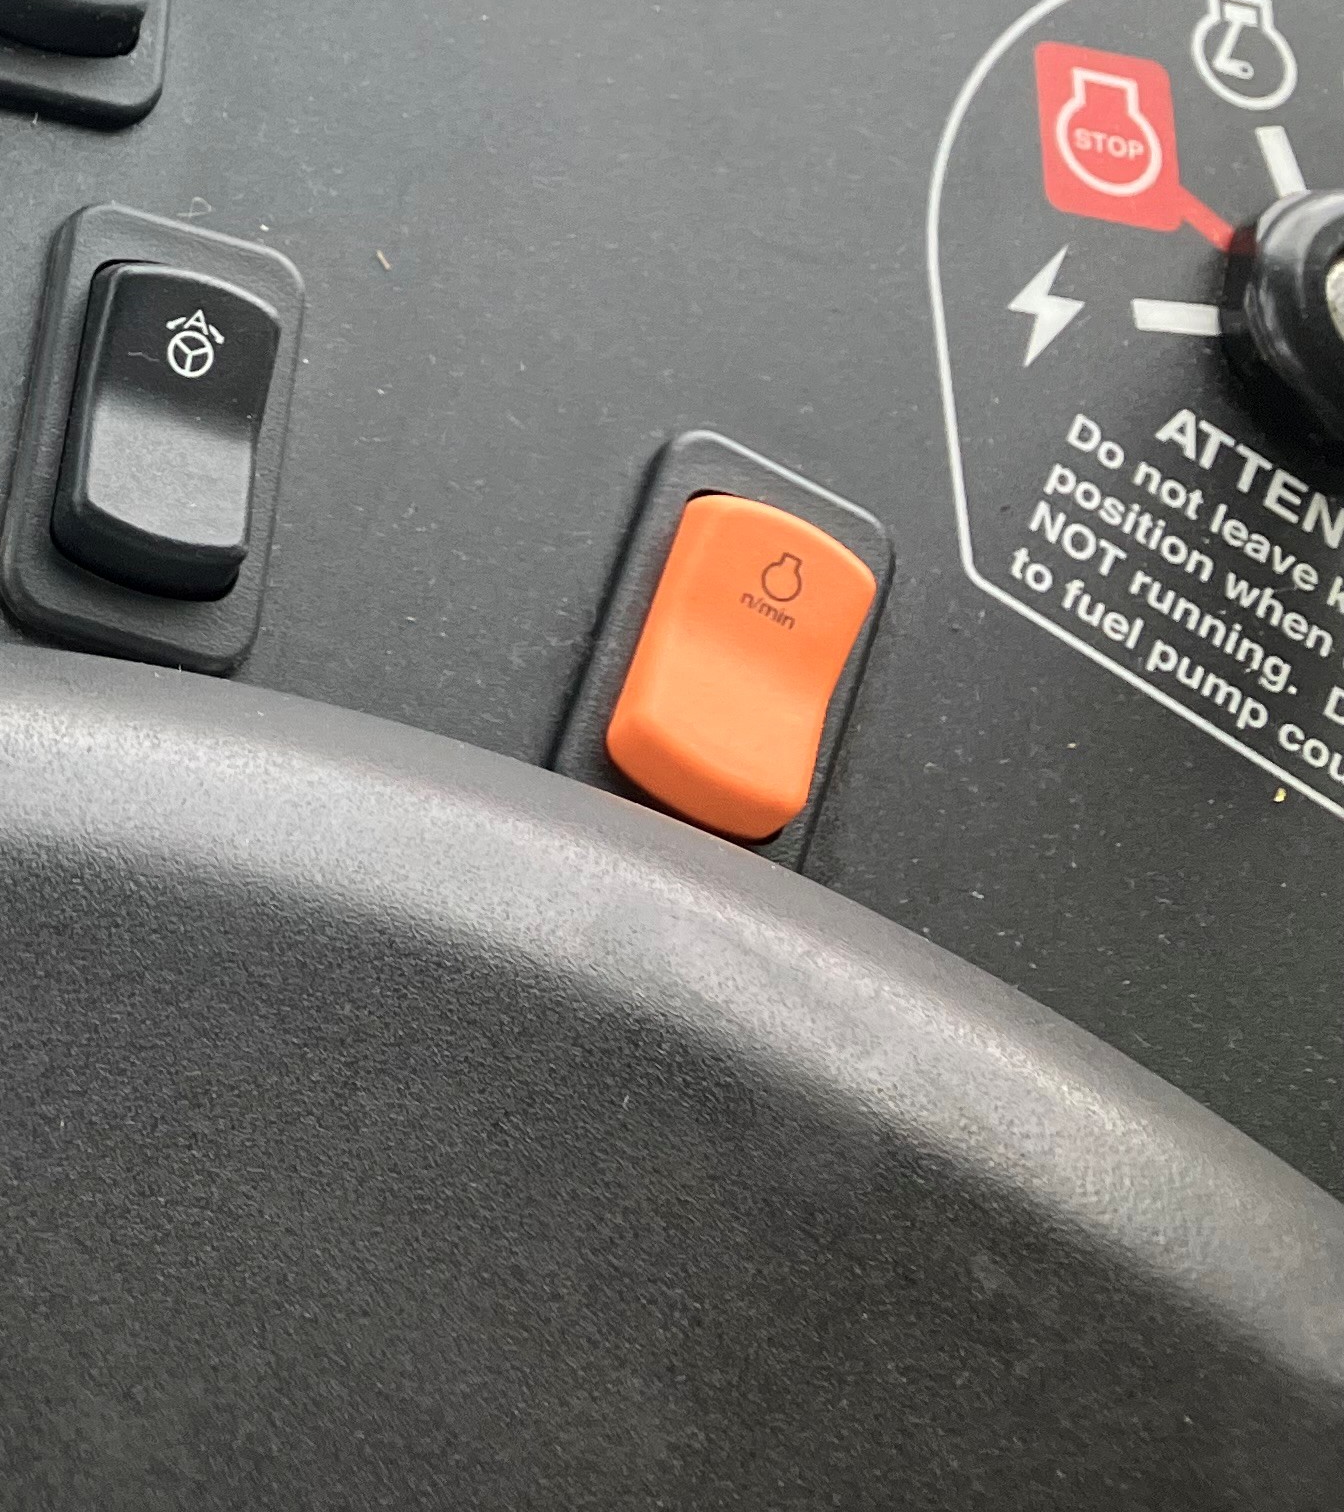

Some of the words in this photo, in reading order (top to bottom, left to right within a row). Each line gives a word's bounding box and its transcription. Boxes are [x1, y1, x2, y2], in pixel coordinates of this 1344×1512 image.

[1073, 127, 1144, 161] STOP
[1044, 463, 1214, 583] position
[1225, 572, 1334, 658] when
[1068, 414, 1125, 469] Do
[1133, 462, 1204, 520] not
[1210, 503, 1319, 591] leave
[1155, 409, 1344, 549] ATTEN
[739, 592, 796, 630] n/min
[1012, 547, 1053, 592] to
[1062, 579, 1144, 649] fuel
[1146, 640, 1269, 730] pump
[1029, 500, 1127, 576] NOT
[1129, 570, 1297, 694] running.
